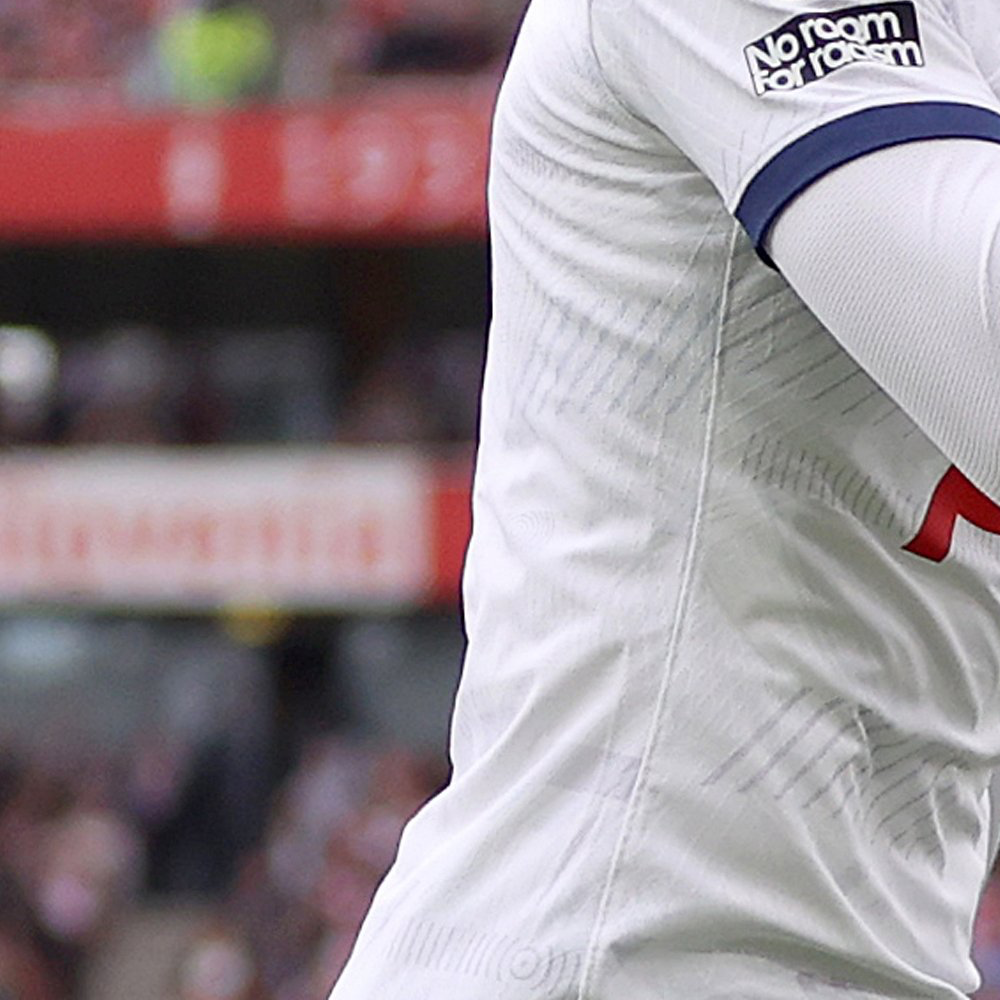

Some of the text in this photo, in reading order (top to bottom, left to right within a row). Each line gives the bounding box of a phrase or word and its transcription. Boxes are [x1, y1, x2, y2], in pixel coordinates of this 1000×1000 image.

[745, 11, 900, 70] No room
[808, 40, 924, 77] racsm
